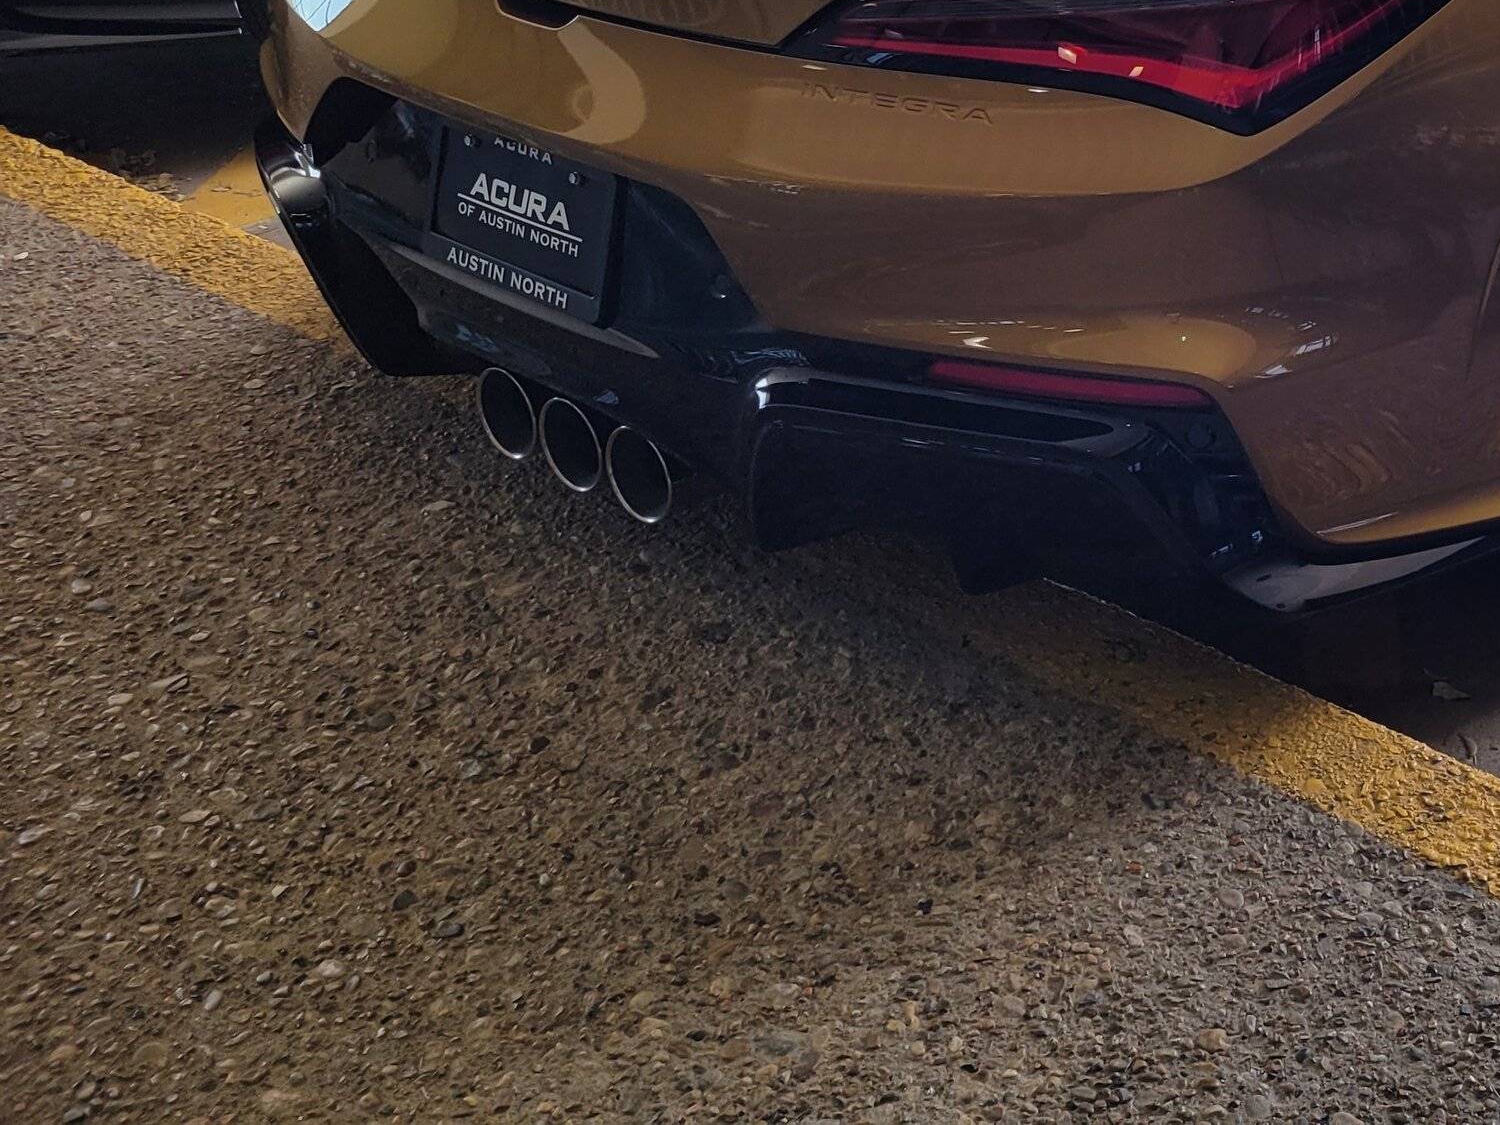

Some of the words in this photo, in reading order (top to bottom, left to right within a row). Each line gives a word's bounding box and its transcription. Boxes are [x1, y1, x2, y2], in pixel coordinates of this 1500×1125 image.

[802, 82, 993, 126] INTEGRA
[493, 136, 553, 165] ACURA
[457, 201, 475, 218] OF
[478, 210, 526, 239] AUSTIN
[529, 228, 579, 258] NORTH
[469, 172, 570, 231] ACURA
[446, 246, 504, 283] AUSTIN
[509, 271, 568, 309] NORTH
